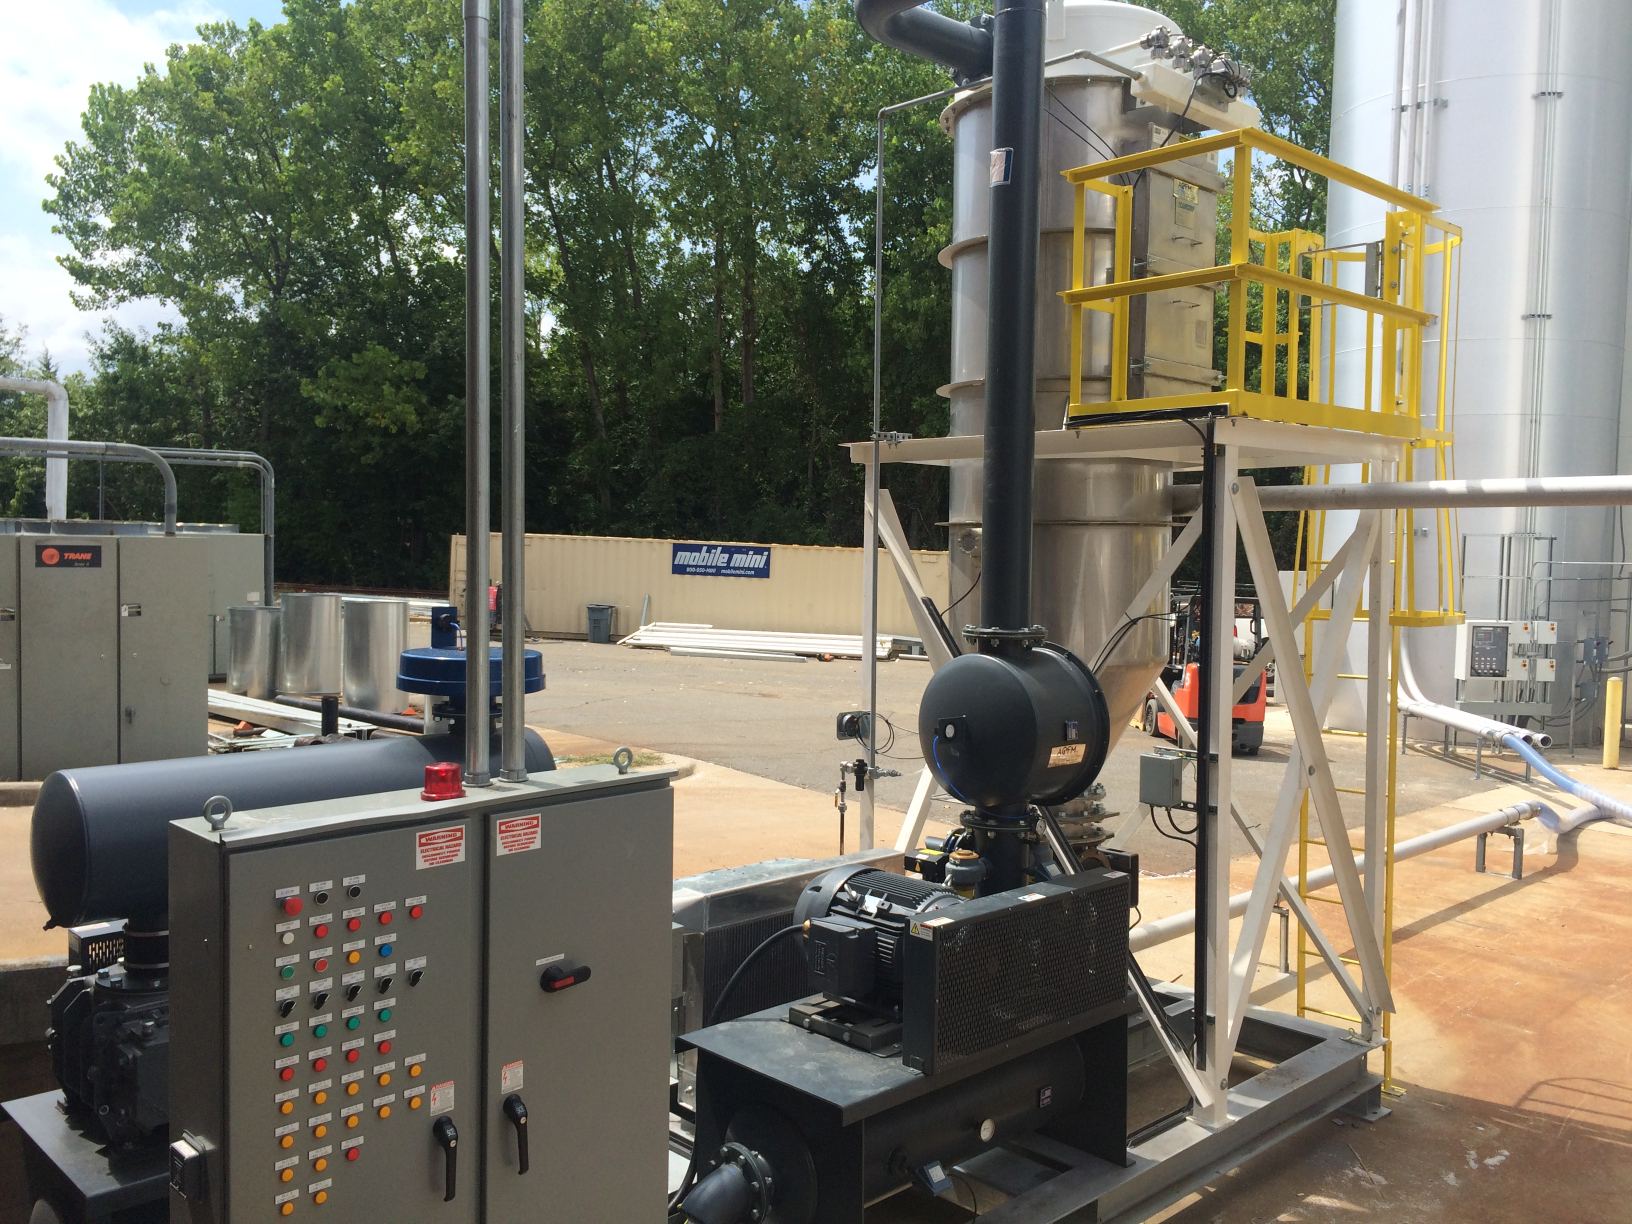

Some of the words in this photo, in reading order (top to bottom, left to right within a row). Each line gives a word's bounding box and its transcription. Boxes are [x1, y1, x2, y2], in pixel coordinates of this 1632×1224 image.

[674, 546, 729, 567] mobile
[730, 550, 769, 569] mini
[505, 820, 535, 830] WARNING
[425, 832, 458, 842] WARNING
